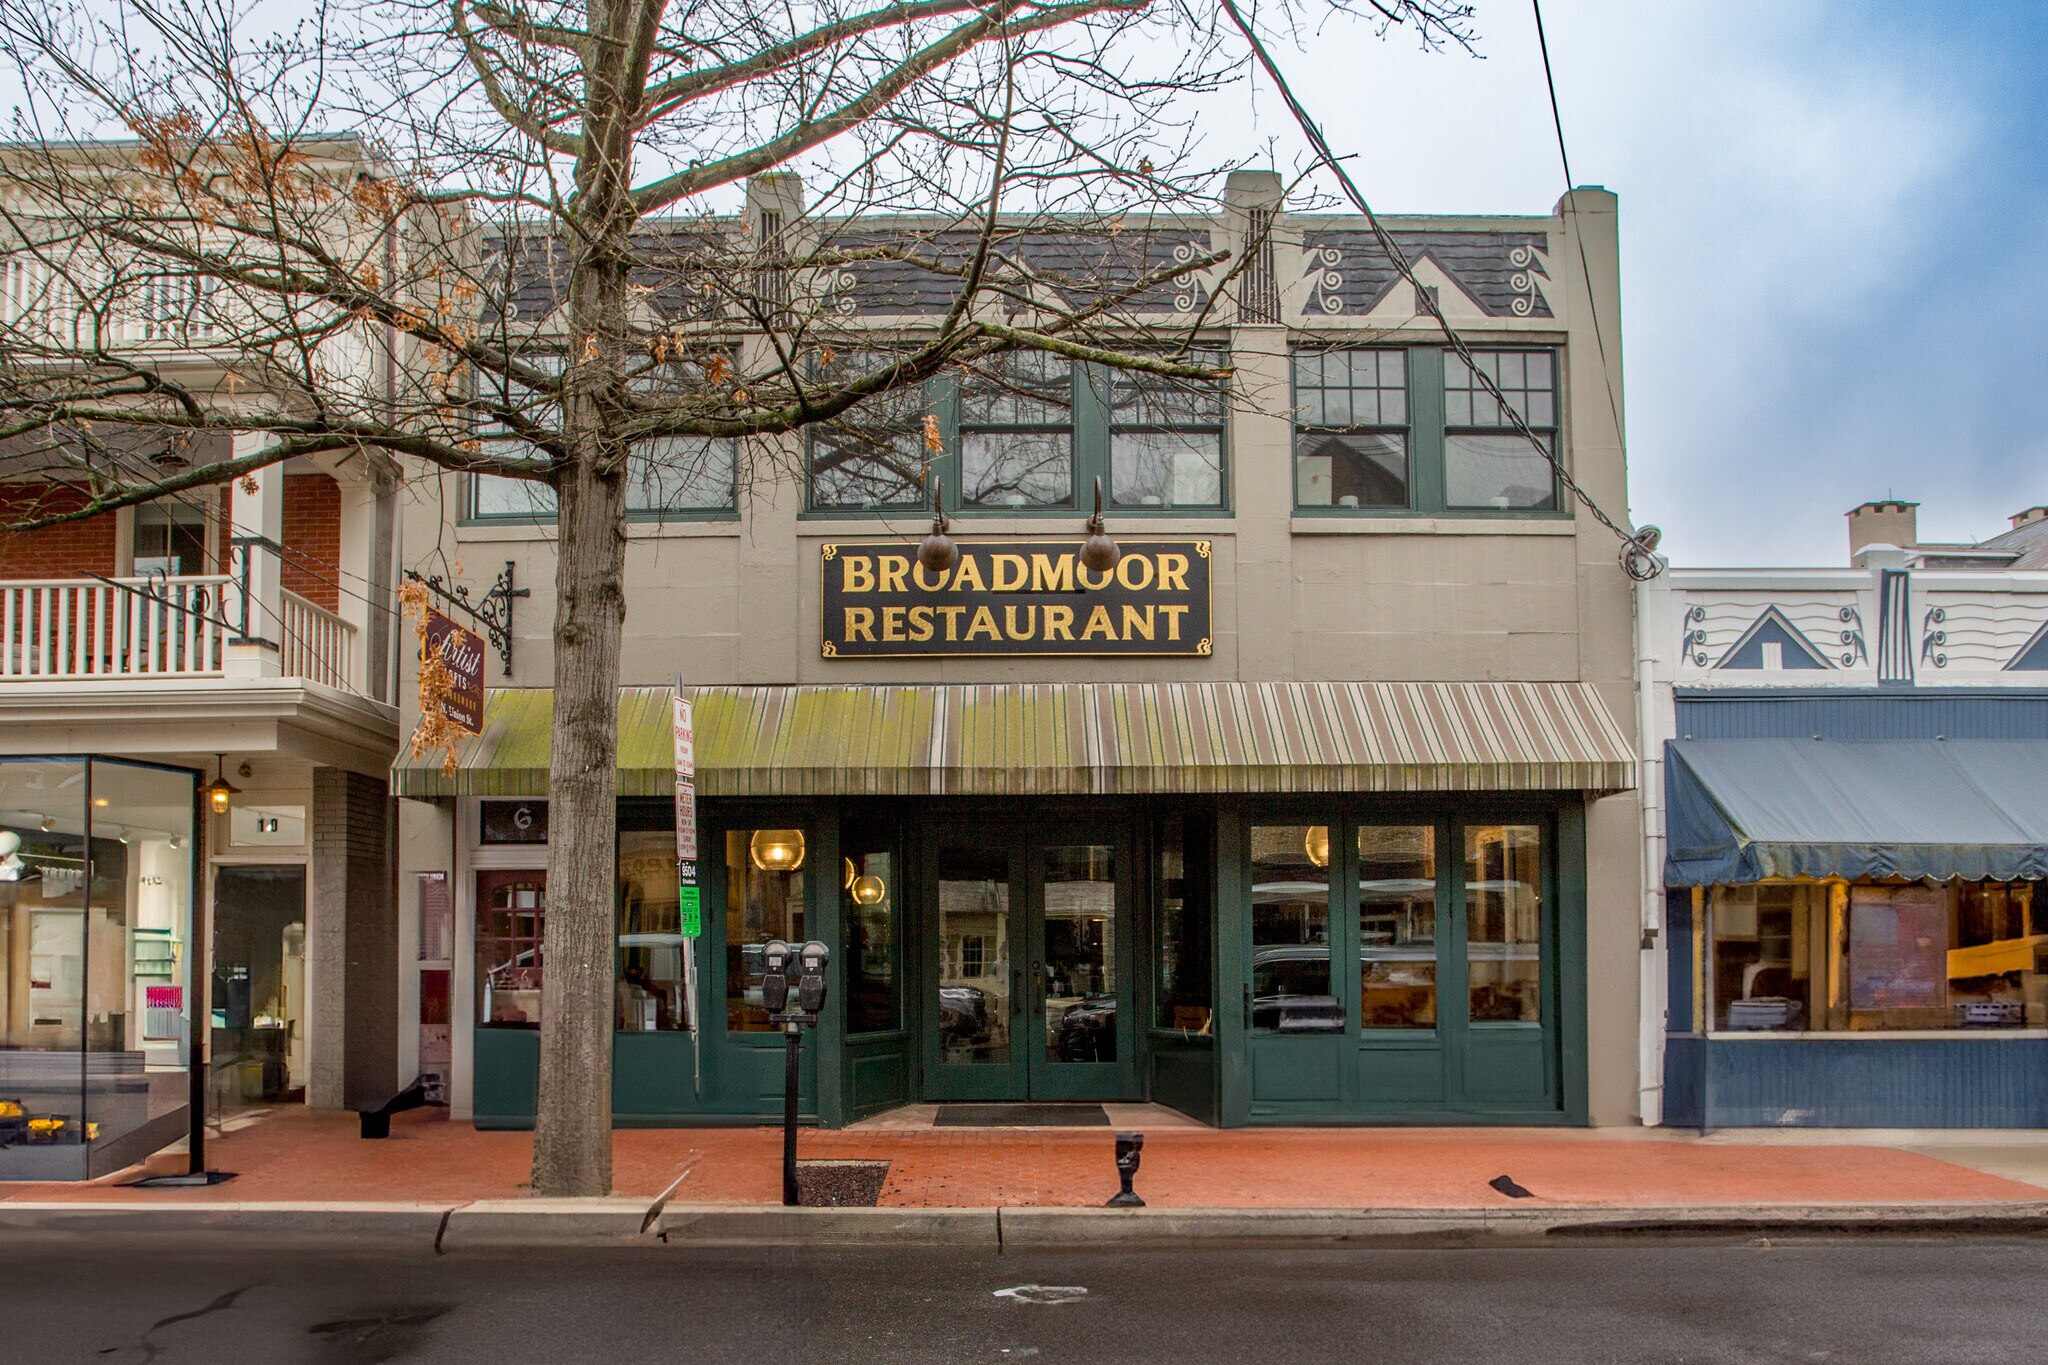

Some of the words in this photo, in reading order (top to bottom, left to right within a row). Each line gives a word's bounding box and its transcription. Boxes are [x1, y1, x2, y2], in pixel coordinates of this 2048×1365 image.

[841, 553, 1190, 593] BROADMOOR
[844, 604, 1189, 642] RESTAURANT
[430, 626, 480, 676] Artist
[449, 704, 466, 723] Union
[676, 725, 692, 744] PARKING
[258, 818, 278, 832] 10
